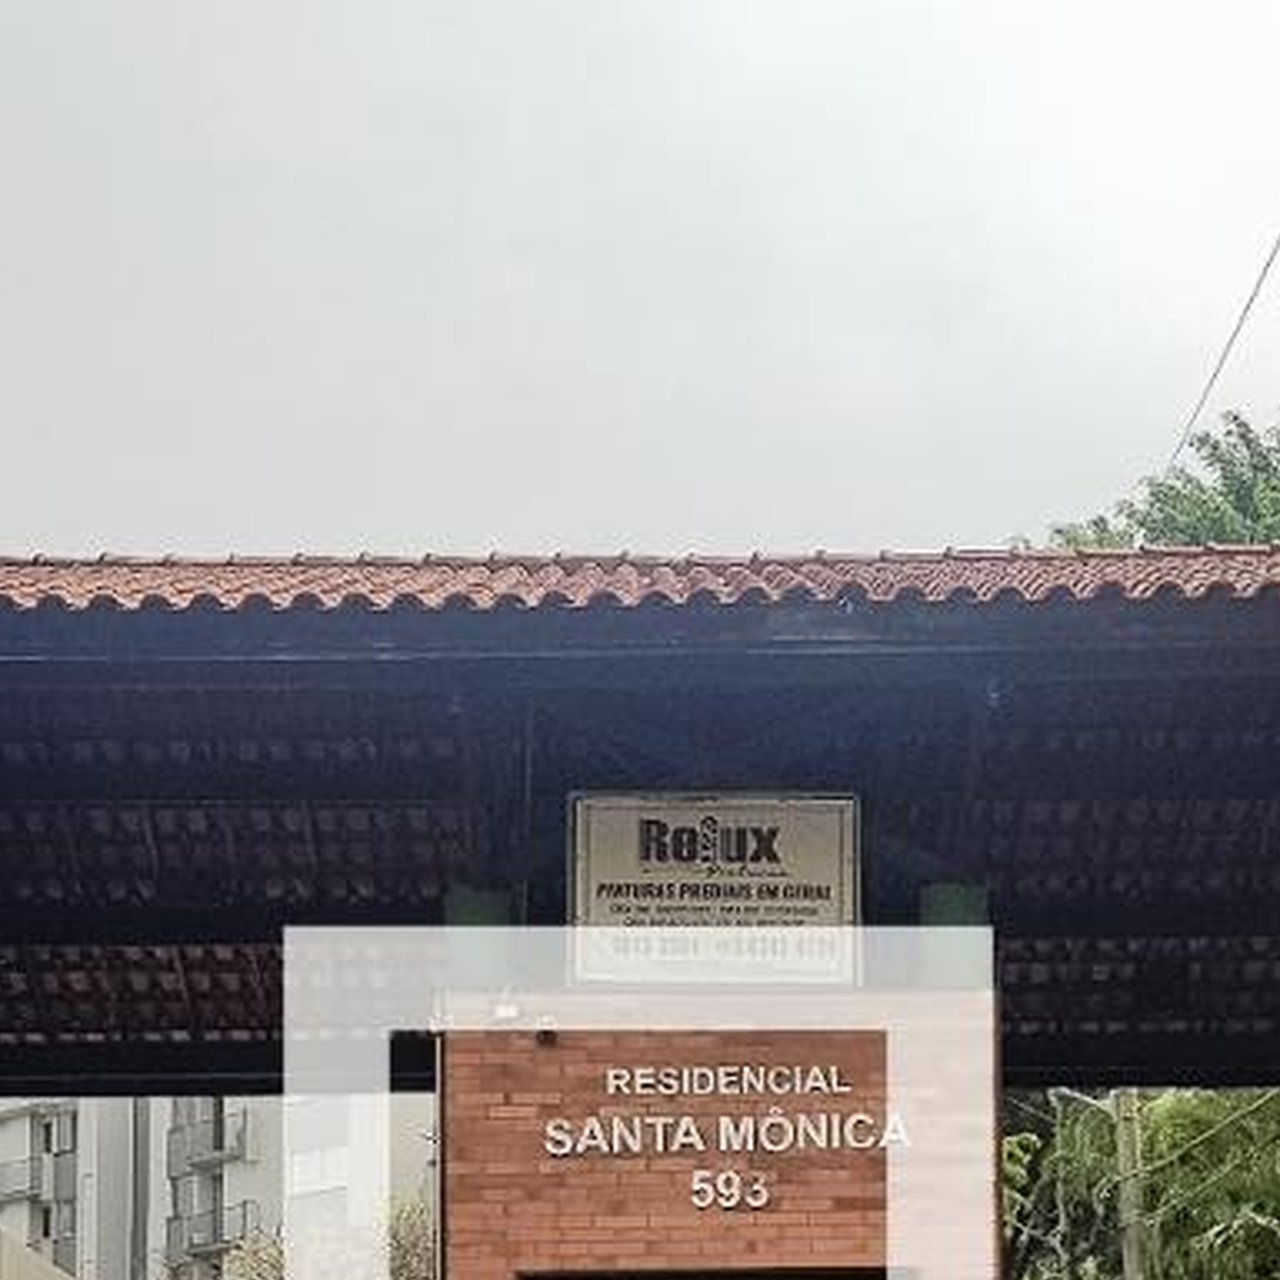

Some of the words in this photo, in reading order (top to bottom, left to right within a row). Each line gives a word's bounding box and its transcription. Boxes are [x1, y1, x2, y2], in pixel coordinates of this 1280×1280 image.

[606, 1065, 854, 1096] RESIDENCIAL
[544, 1115, 706, 1156] SANTA
[717, 1106, 911, 1153] MÔNICA
[690, 1168, 770, 1209] 593
